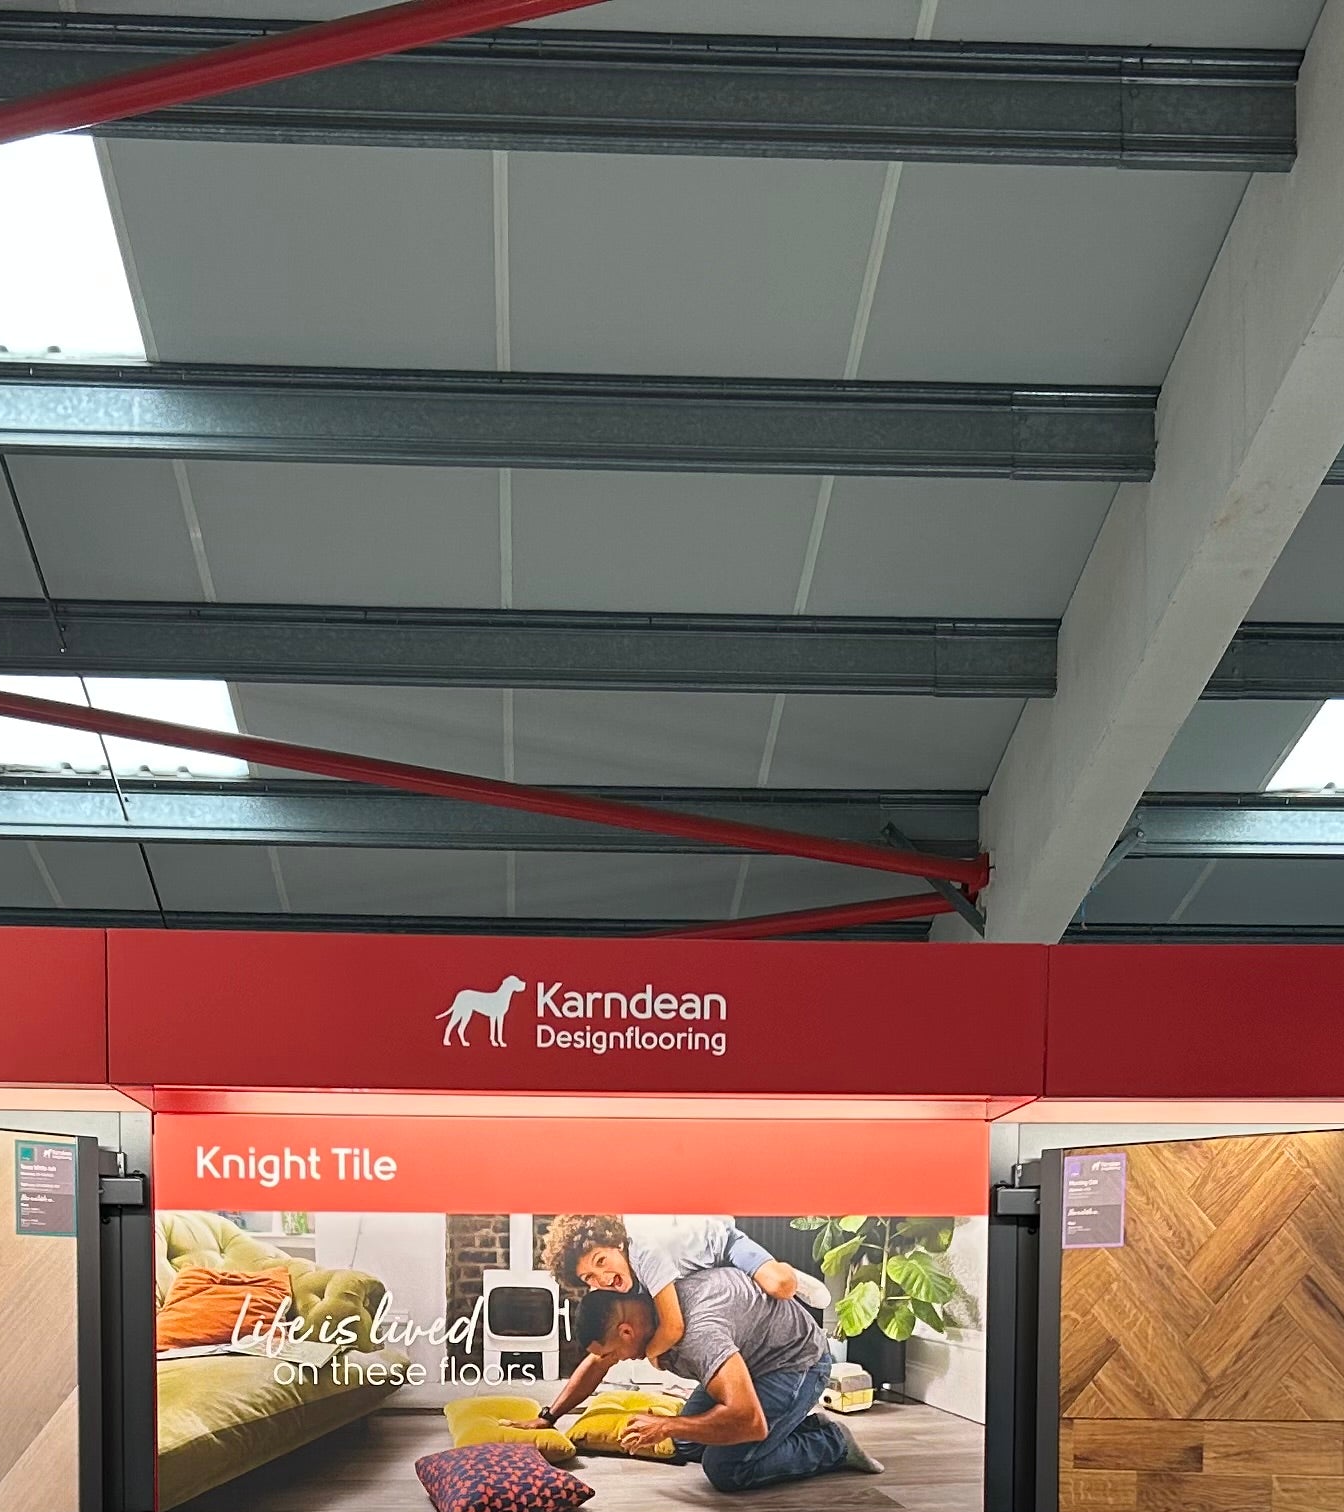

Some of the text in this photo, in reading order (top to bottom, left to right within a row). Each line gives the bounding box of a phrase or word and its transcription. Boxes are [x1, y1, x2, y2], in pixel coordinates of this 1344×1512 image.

[536, 982, 727, 1020] Karndean
[536, 1024, 727, 1056] Designflooring
[196, 1145, 397, 1188] Knight Tile
[230, 1290, 485, 1359] Life is lived
[273, 1356, 536, 1386] on these floors
